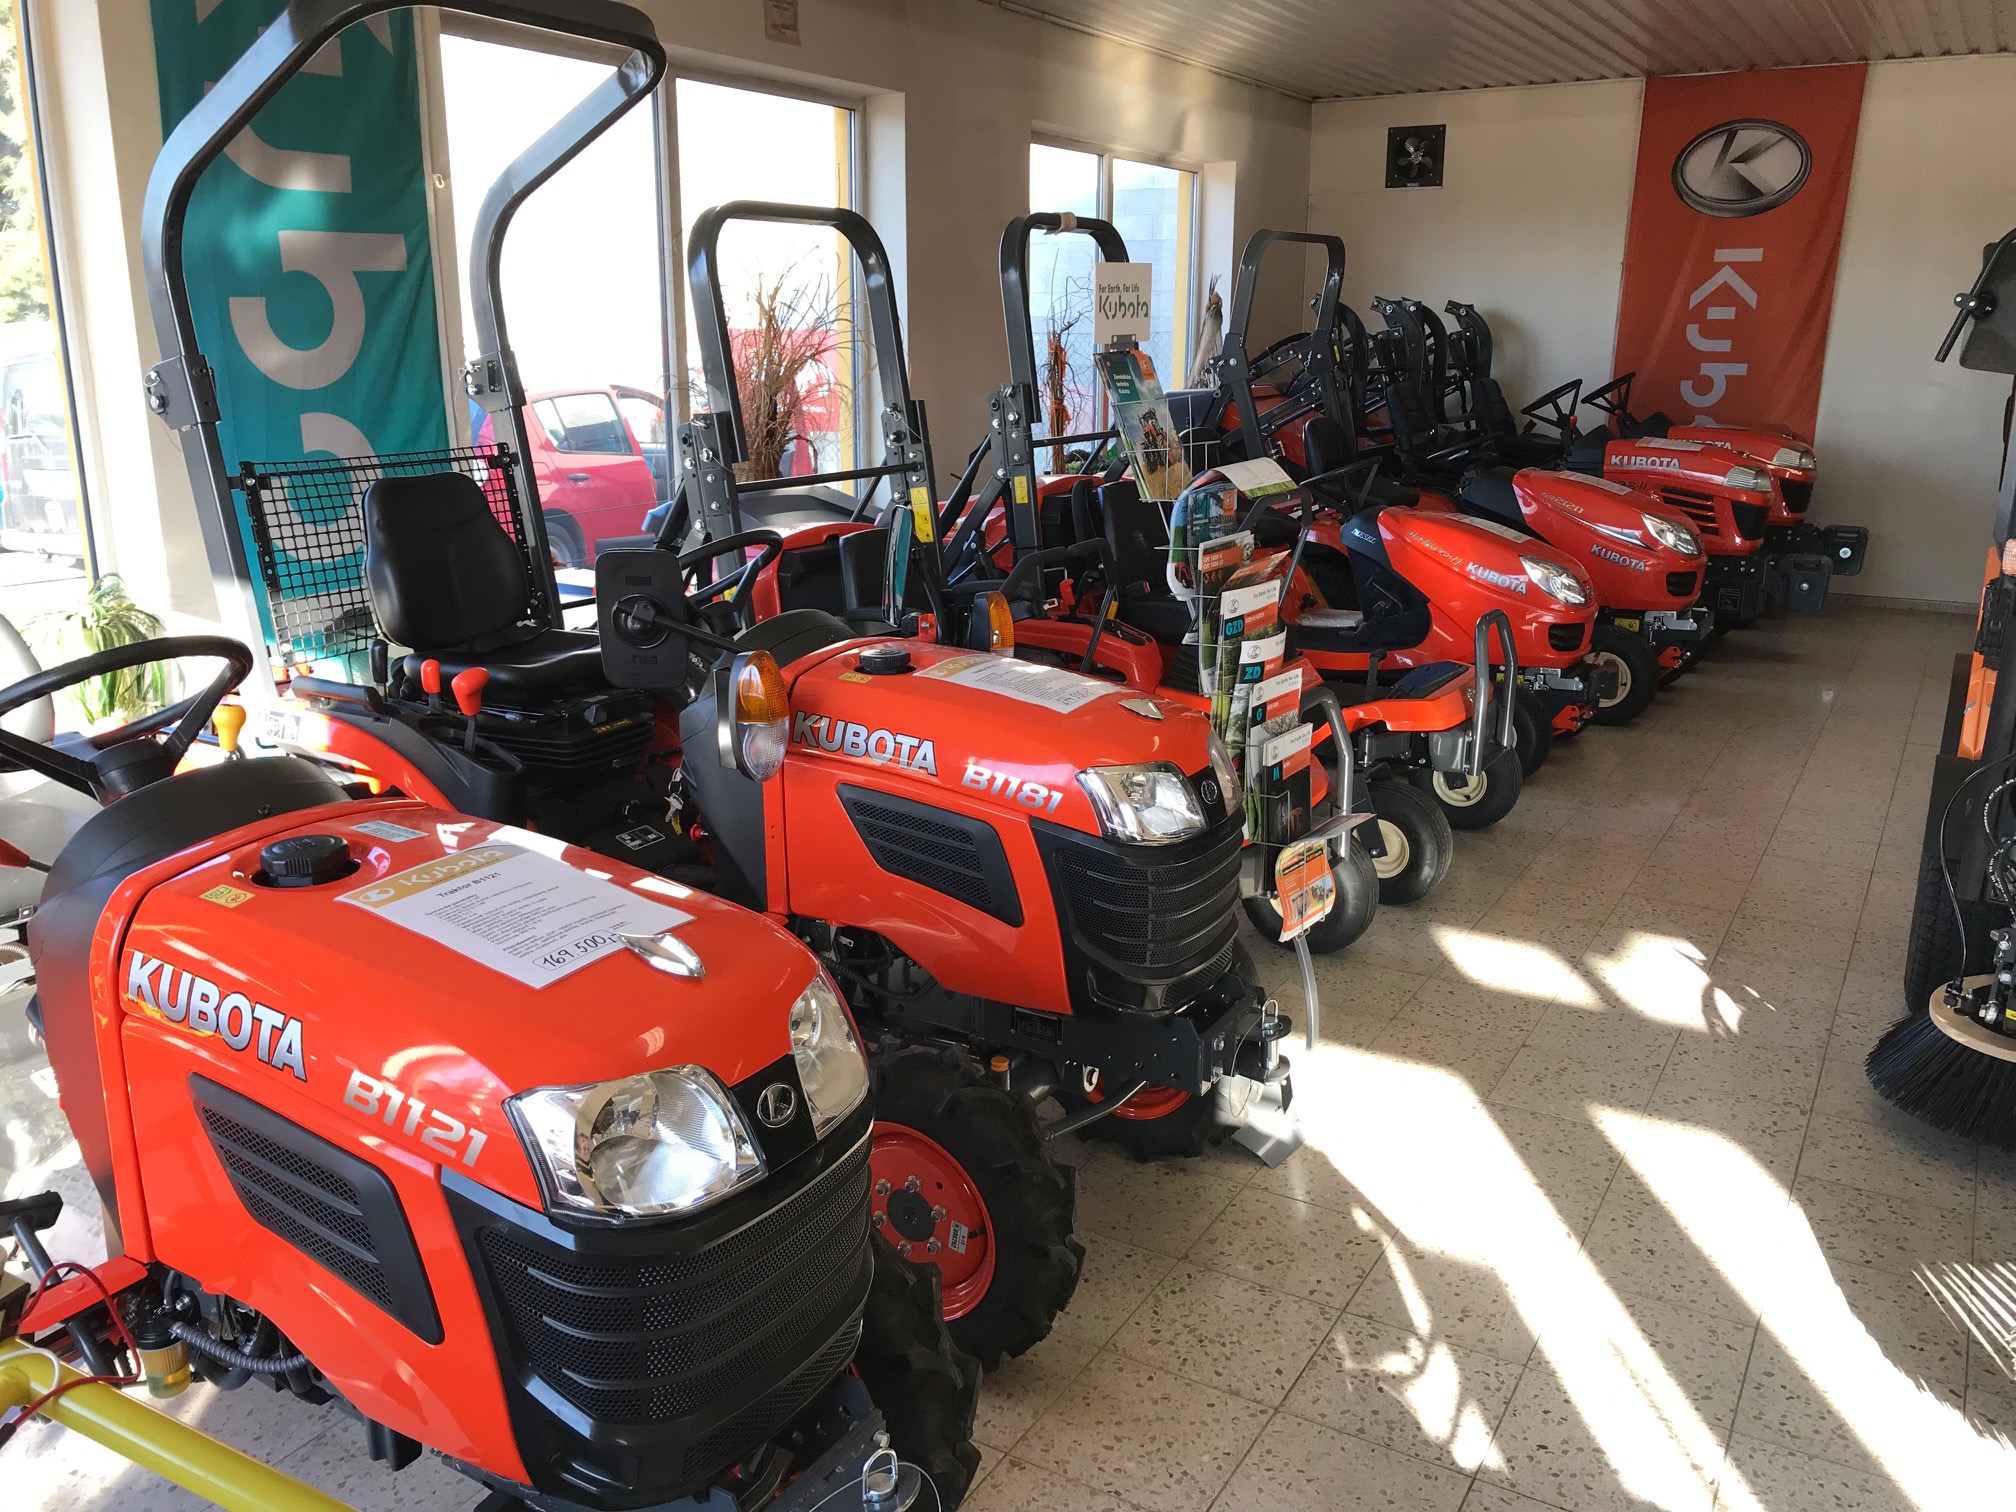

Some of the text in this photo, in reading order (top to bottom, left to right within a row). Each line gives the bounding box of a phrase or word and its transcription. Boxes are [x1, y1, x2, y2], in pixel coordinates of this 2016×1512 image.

[1099, 294, 1149, 319] Kubota
[1680, 247, 1764, 428] Kub
[1610, 454, 1680, 470] KUBOTA
[1350, 528, 1377, 545] DIESEL
[1590, 544, 1646, 572] KUBOTA
[1465, 561, 1528, 595] KUBOTA
[1225, 619, 1244, 636] GZD
[1243, 666, 1262, 680] ZD
[1256, 707, 1263, 721] G
[792, 710, 939, 776] KUBOTA
[960, 764, 1064, 814] B1181
[398, 850, 505, 886] Kubota
[436, 881, 473, 898] Traktor
[471, 872, 501, 885] B1121
[127, 949, 308, 1083] KUBOTA
[342, 1069, 489, 1167] B1121
